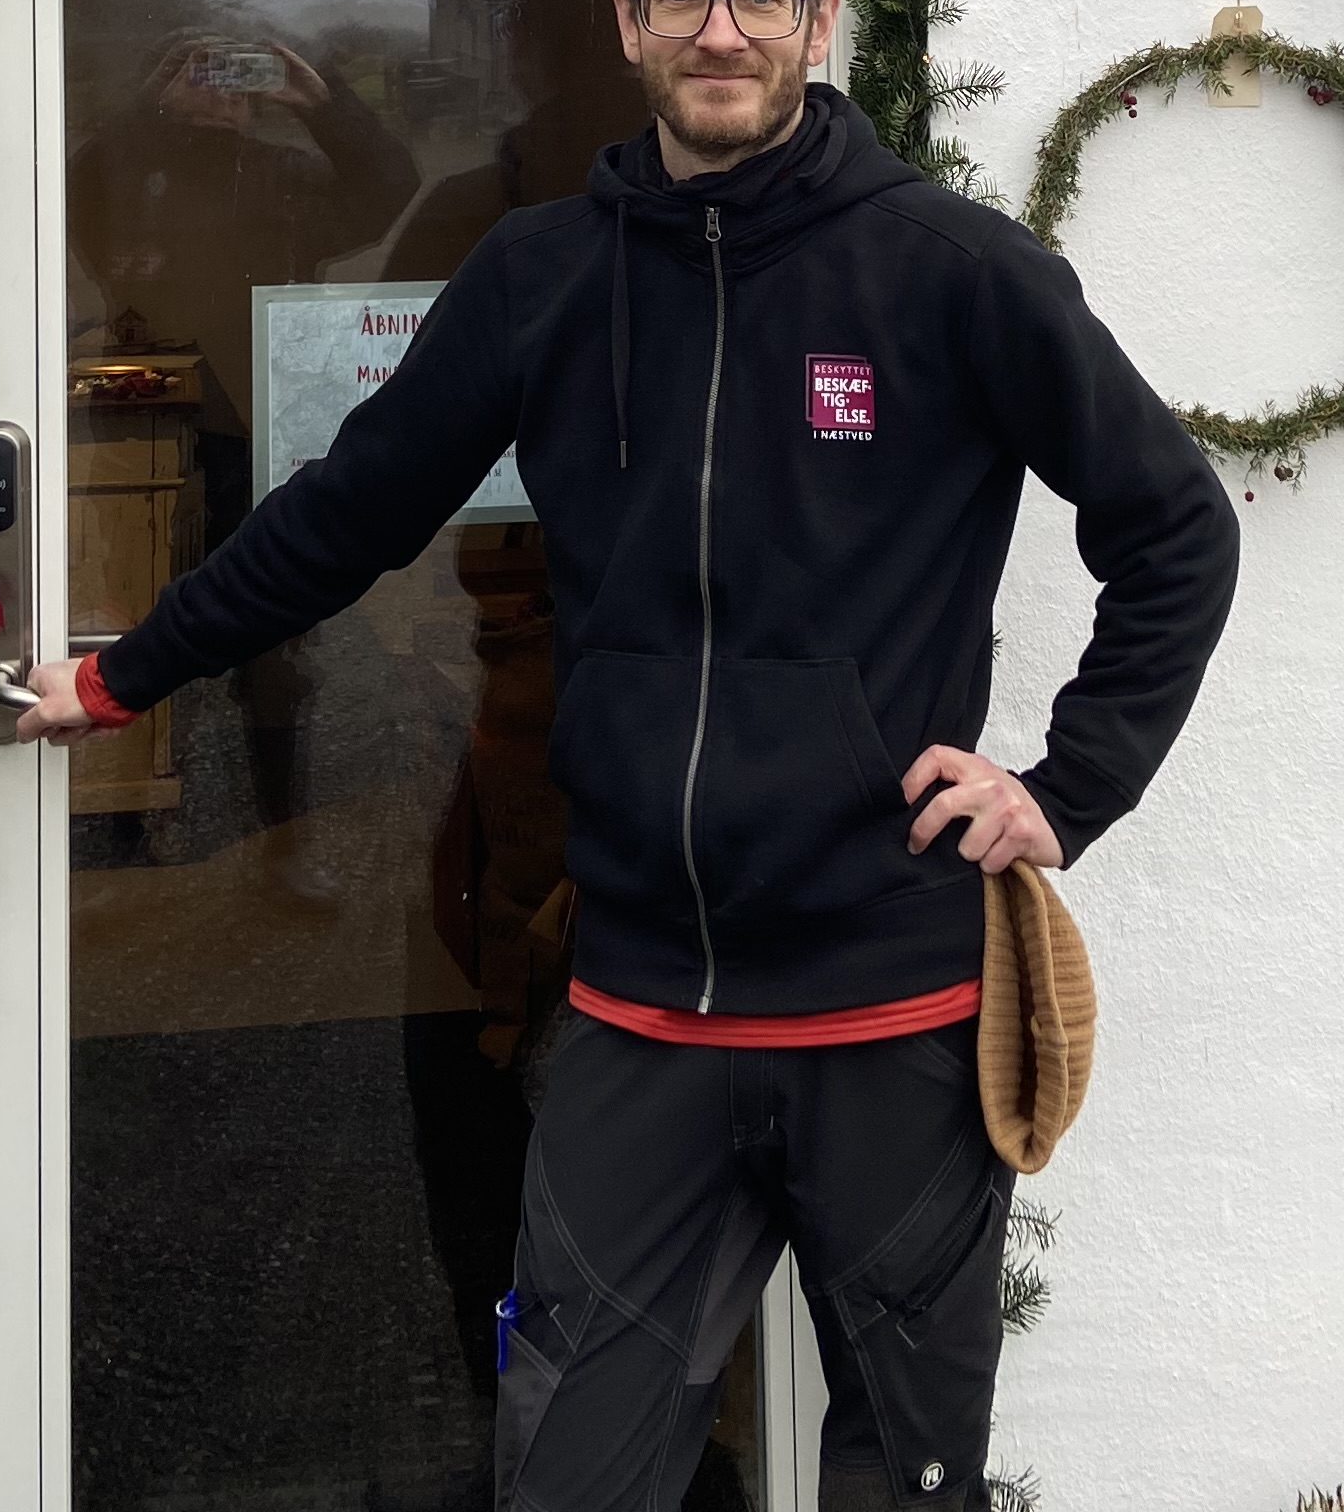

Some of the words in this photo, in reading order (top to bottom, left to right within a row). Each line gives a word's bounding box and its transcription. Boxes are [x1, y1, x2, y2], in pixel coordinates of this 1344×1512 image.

[357, 365, 398, 383] MAN
[814, 364, 871, 376] BESKYTTET
[835, 408, 871, 424] ELSE.
[813, 430, 817, 440] I
[820, 430, 873, 441] NÆSTVED
